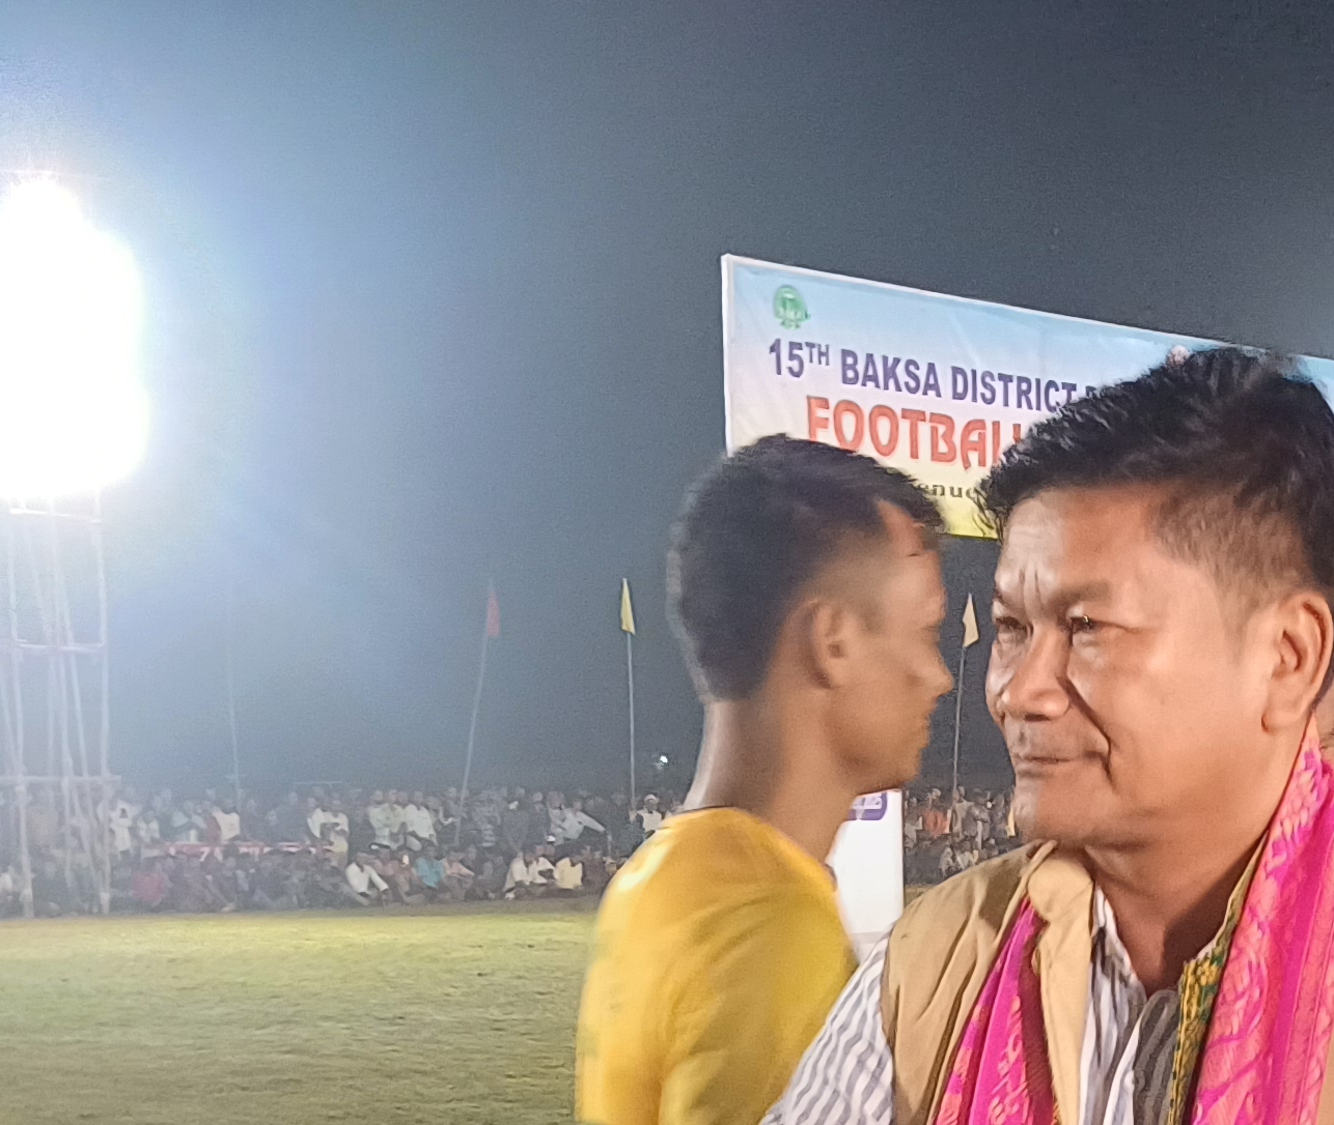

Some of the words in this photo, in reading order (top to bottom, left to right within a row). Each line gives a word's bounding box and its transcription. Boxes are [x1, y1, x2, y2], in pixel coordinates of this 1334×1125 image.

[768, 338, 830, 378] 15TH
[840, 348, 942, 398] BAKSA
[951, 366, 1077, 413] DISTRICT
